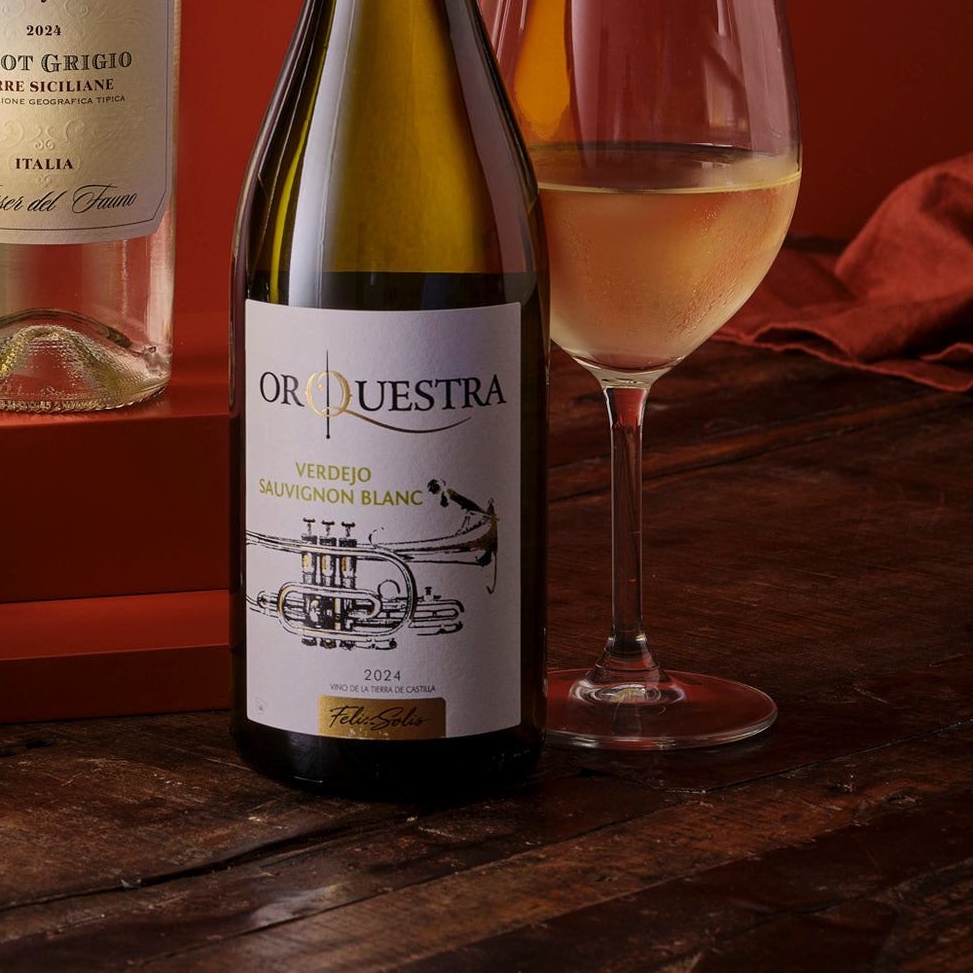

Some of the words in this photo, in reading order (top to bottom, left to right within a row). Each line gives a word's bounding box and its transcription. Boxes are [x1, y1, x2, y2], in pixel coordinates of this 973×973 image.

[26, 25, 62, 36] 2024
[40, 51, 133, 73] GRIGIO
[29, 78, 115, 93] SICILIANE
[28, 97, 94, 106] GEOGRAFICA
[96, 94, 126, 104] TIPICA
[15, 158, 74, 170] ITALIA
[27, 190, 69, 213] del
[71, 183, 138, 214] Fauno
[259, 370, 507, 433] ORQUESTRA
[295, 461, 372, 487] VERDEJO
[258, 478, 354, 505] SAUVIGNON
[360, 489, 424, 507] BLANC
[363, 668, 402, 682] 2024
[329, 683, 348, 692] VINO
[350, 685, 359, 693] DE
[361, 685, 369, 693] LA
[371, 685, 393, 693] TIERRA
[395, 685, 404, 693] DE
[405, 685, 437, 694] CASTILLA
